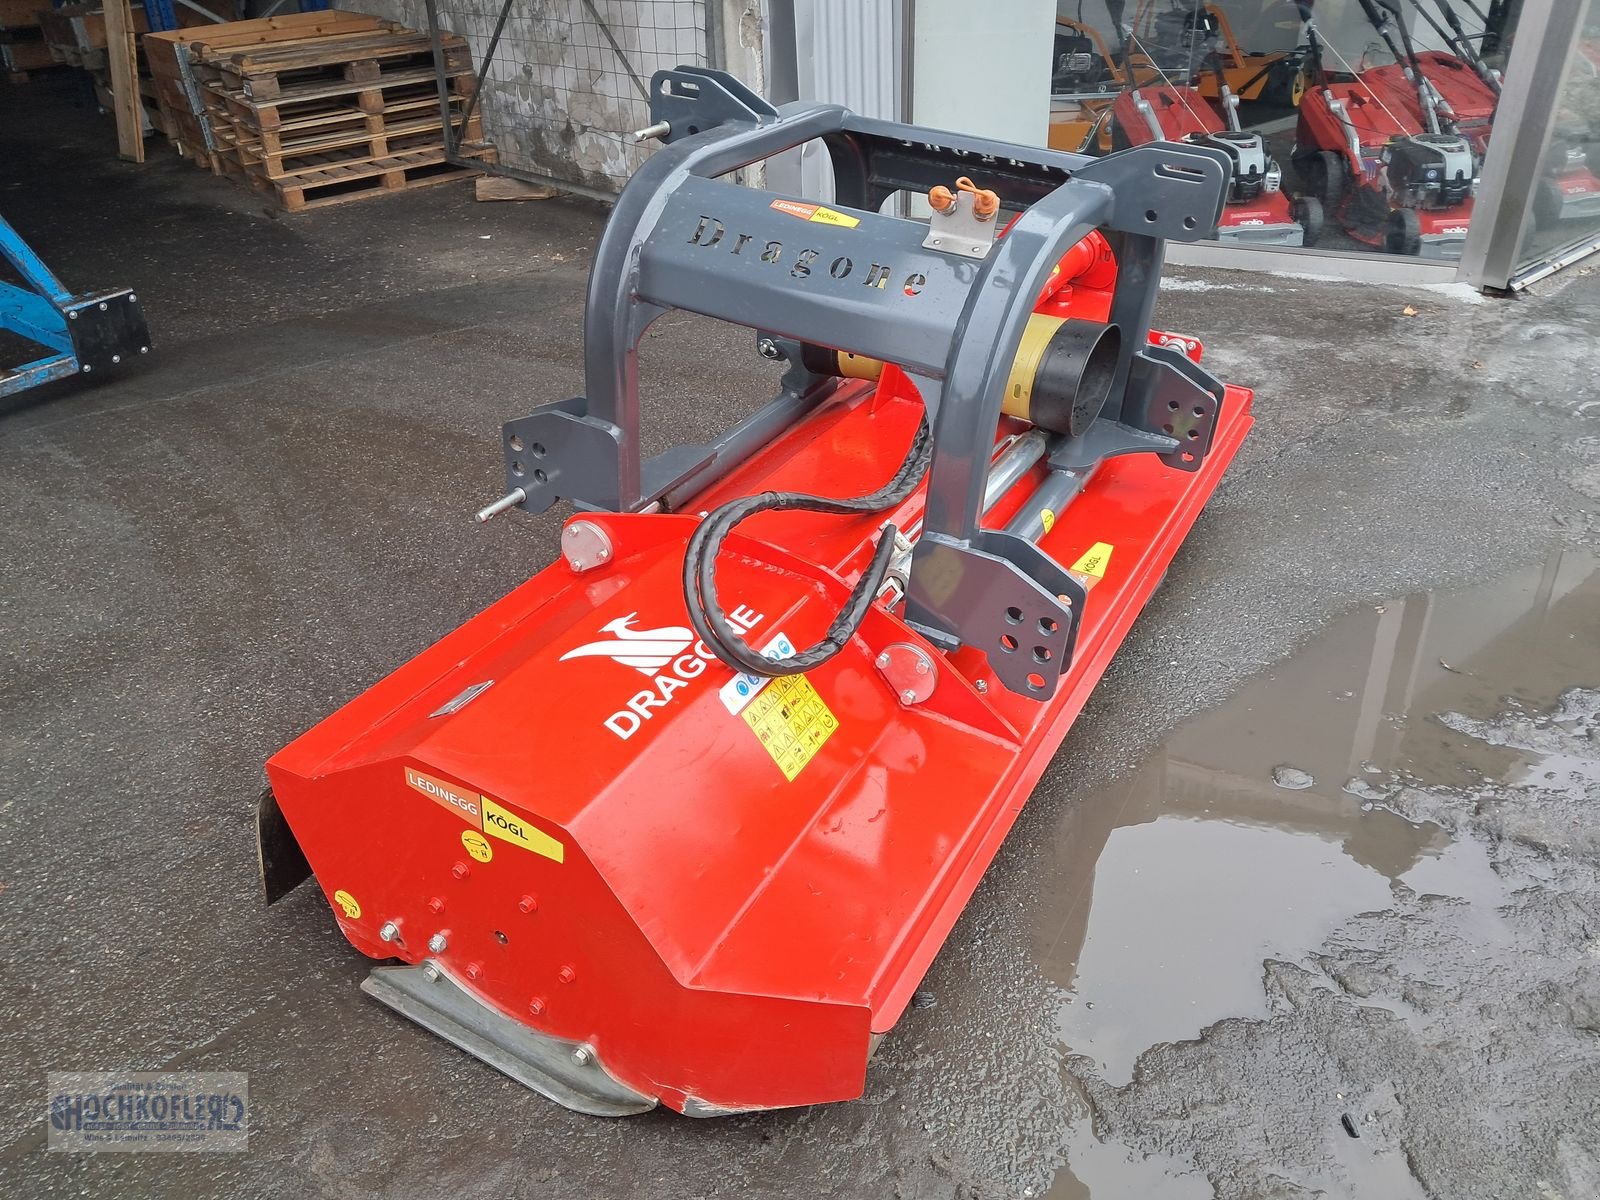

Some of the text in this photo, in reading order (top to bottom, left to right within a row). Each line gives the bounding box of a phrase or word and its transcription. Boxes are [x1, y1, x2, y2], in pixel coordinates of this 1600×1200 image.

[774, 202, 839, 222] LEDINEGG KÖGL
[687, 215, 926, 297] Dragone
[1082, 557, 1101, 572] KÖGL
[409, 773, 529, 841] LEDINEGG KÖGL
